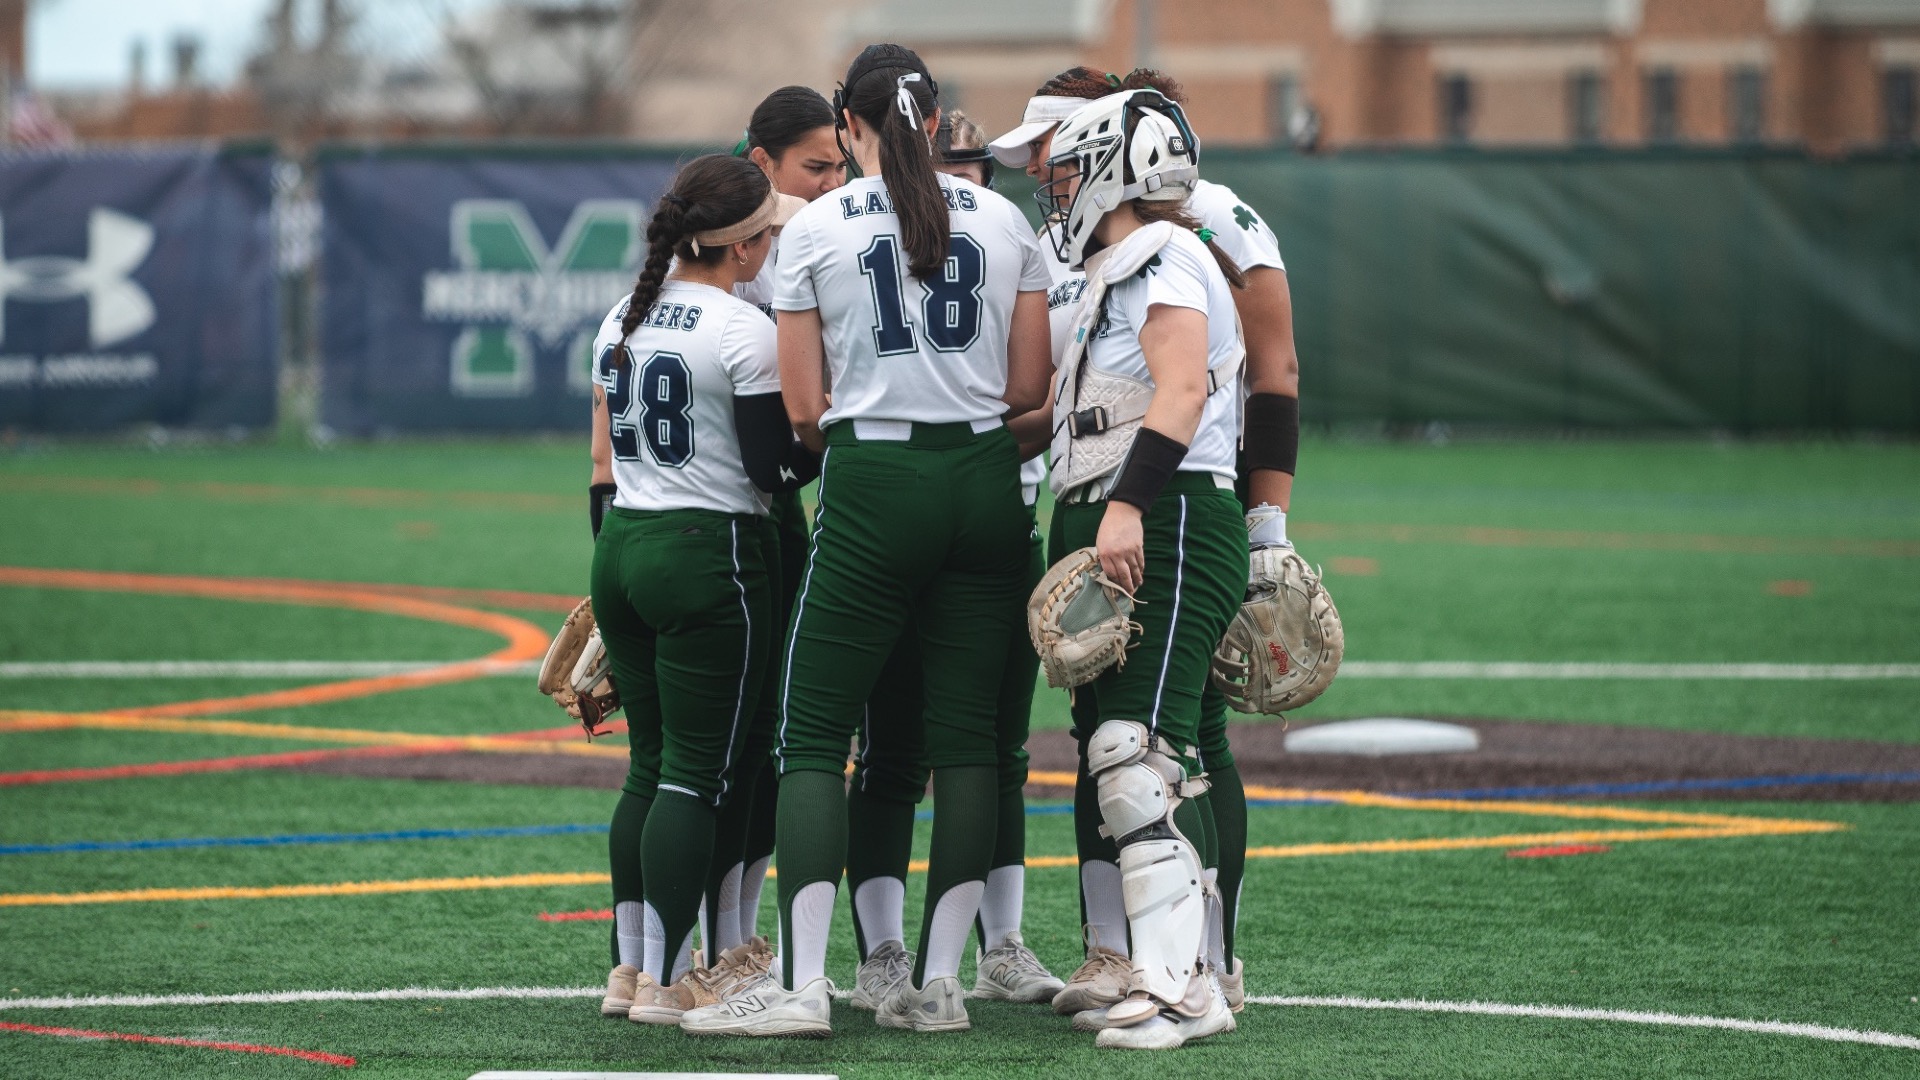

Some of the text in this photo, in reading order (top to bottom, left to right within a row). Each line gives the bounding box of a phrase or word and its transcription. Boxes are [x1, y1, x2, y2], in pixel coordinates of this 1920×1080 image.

[840, 186, 978, 220] LARS
[613, 300, 702, 332] LKERS
[857, 231, 986, 358] 18
[598, 342, 696, 470] 28
